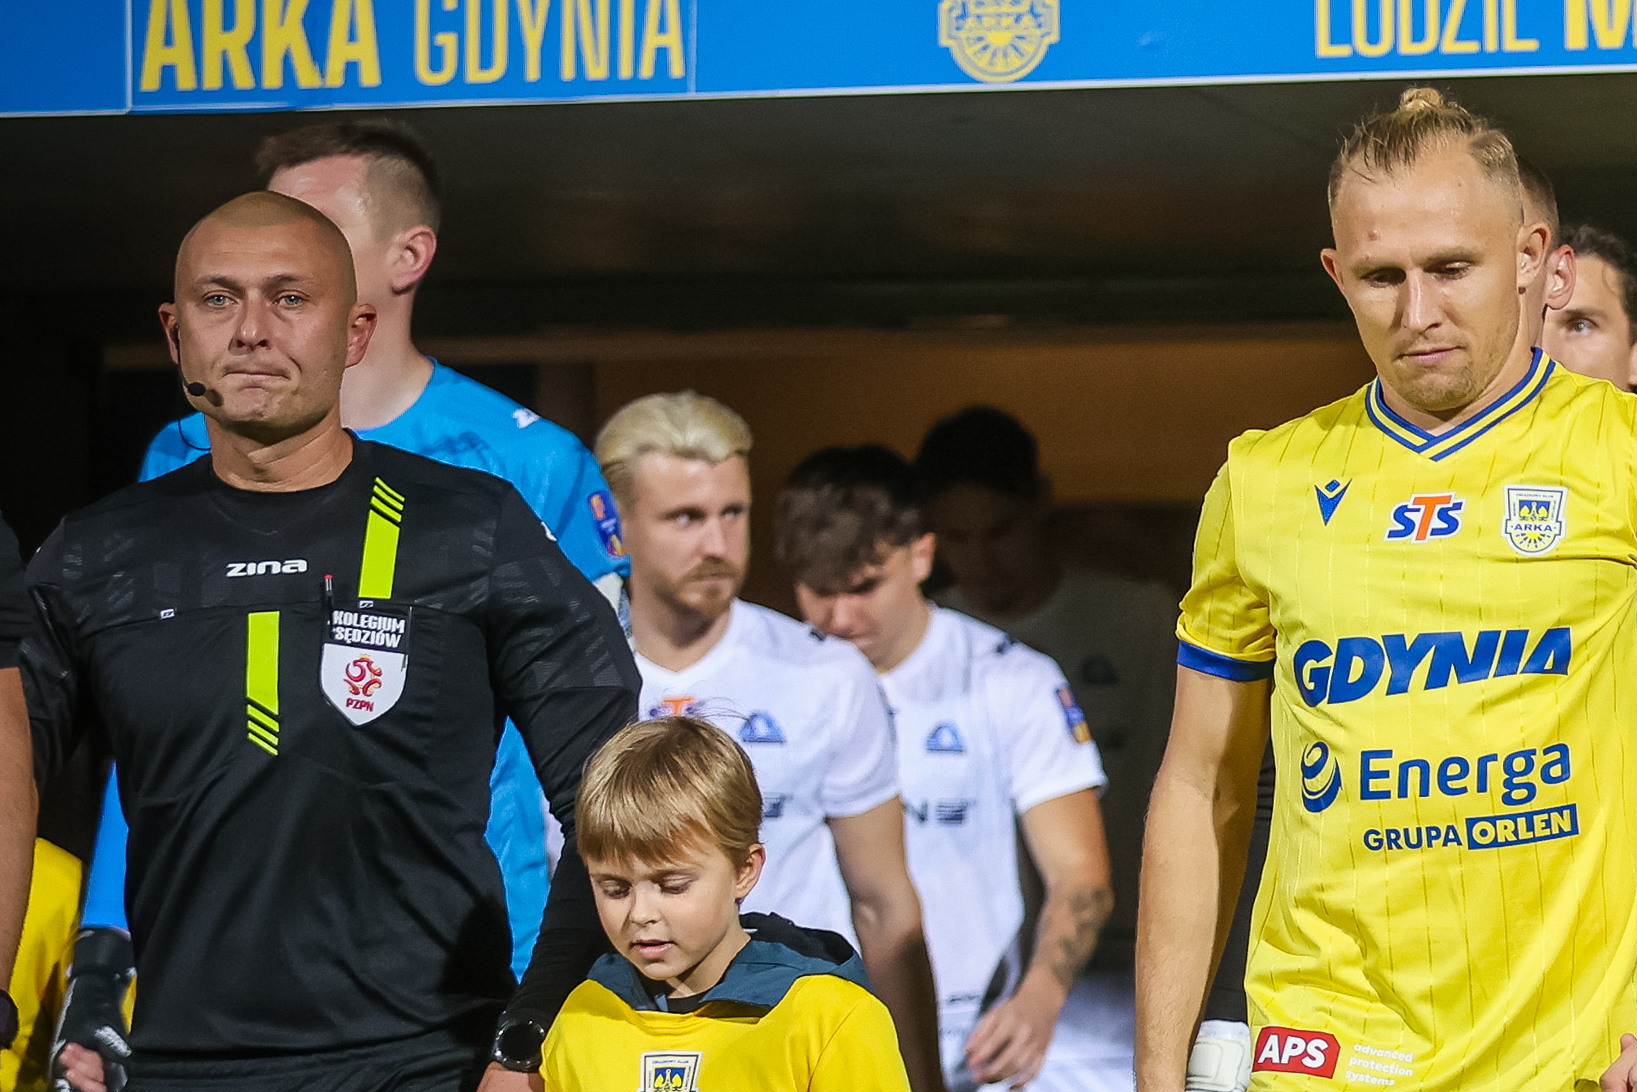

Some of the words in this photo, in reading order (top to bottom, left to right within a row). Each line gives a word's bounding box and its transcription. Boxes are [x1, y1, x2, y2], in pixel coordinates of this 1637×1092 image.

[139, 0, 382, 91] ARKA
[414, 0, 687, 87] GDYNIA
[1386, 494, 1464, 541] STS
[1513, 523, 1553, 532] ARKA
[332, 610, 406, 634] KOLEGIUM
[334, 627, 402, 649] SĘDZIÓW
[1293, 627, 1572, 708] GDYNIA
[346, 698, 375, 712] PZPN
[1360, 742, 1571, 807] Energa
[1363, 824, 1463, 851] GRUPA
[1470, 808, 1573, 846] ORLEN
[1257, 1034, 1329, 1068] APS
[1353, 1043, 1415, 1063] advanced
[1345, 1070, 1396, 1086] systems
[1348, 1056, 1414, 1076] protection
